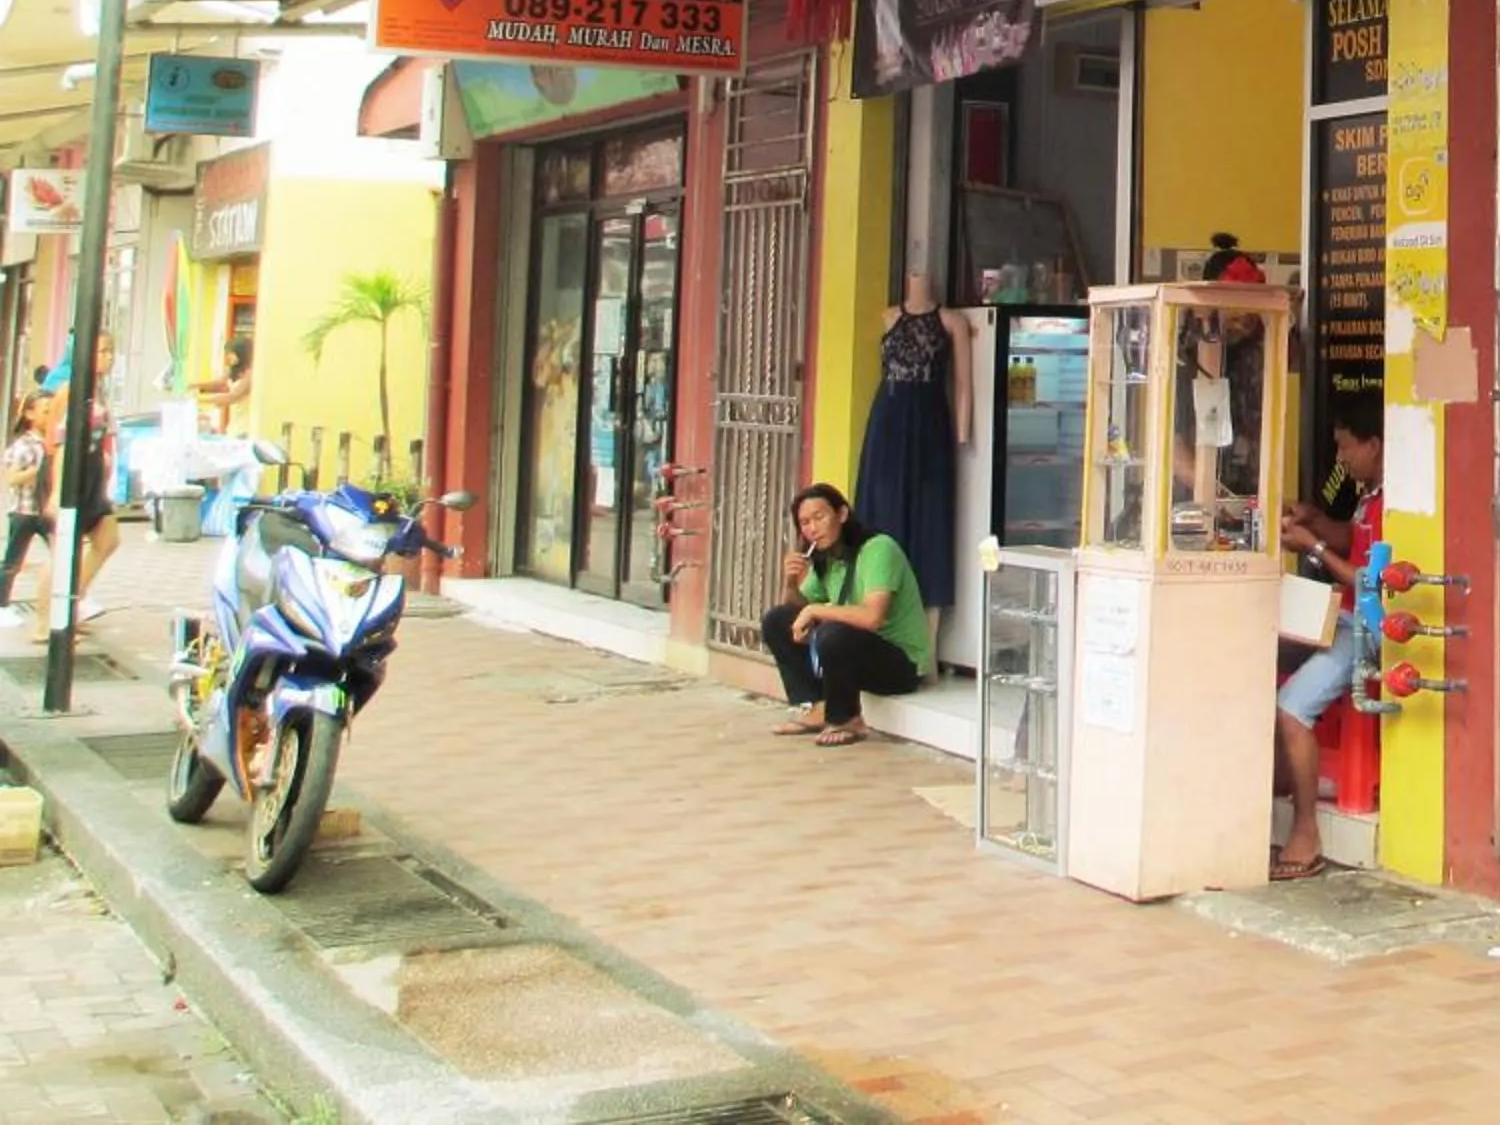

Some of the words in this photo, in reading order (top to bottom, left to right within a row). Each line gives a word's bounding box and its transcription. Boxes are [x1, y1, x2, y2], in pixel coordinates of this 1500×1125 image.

[659, 1, 721, 33] 333
[567, 26, 632, 49] MURAH
[640, 32, 670, 53] Dan
[675, 36, 737, 57] MESRA.
[1331, 24, 1382, 62] POSH
[1335, 125, 1377, 152] SKIM
